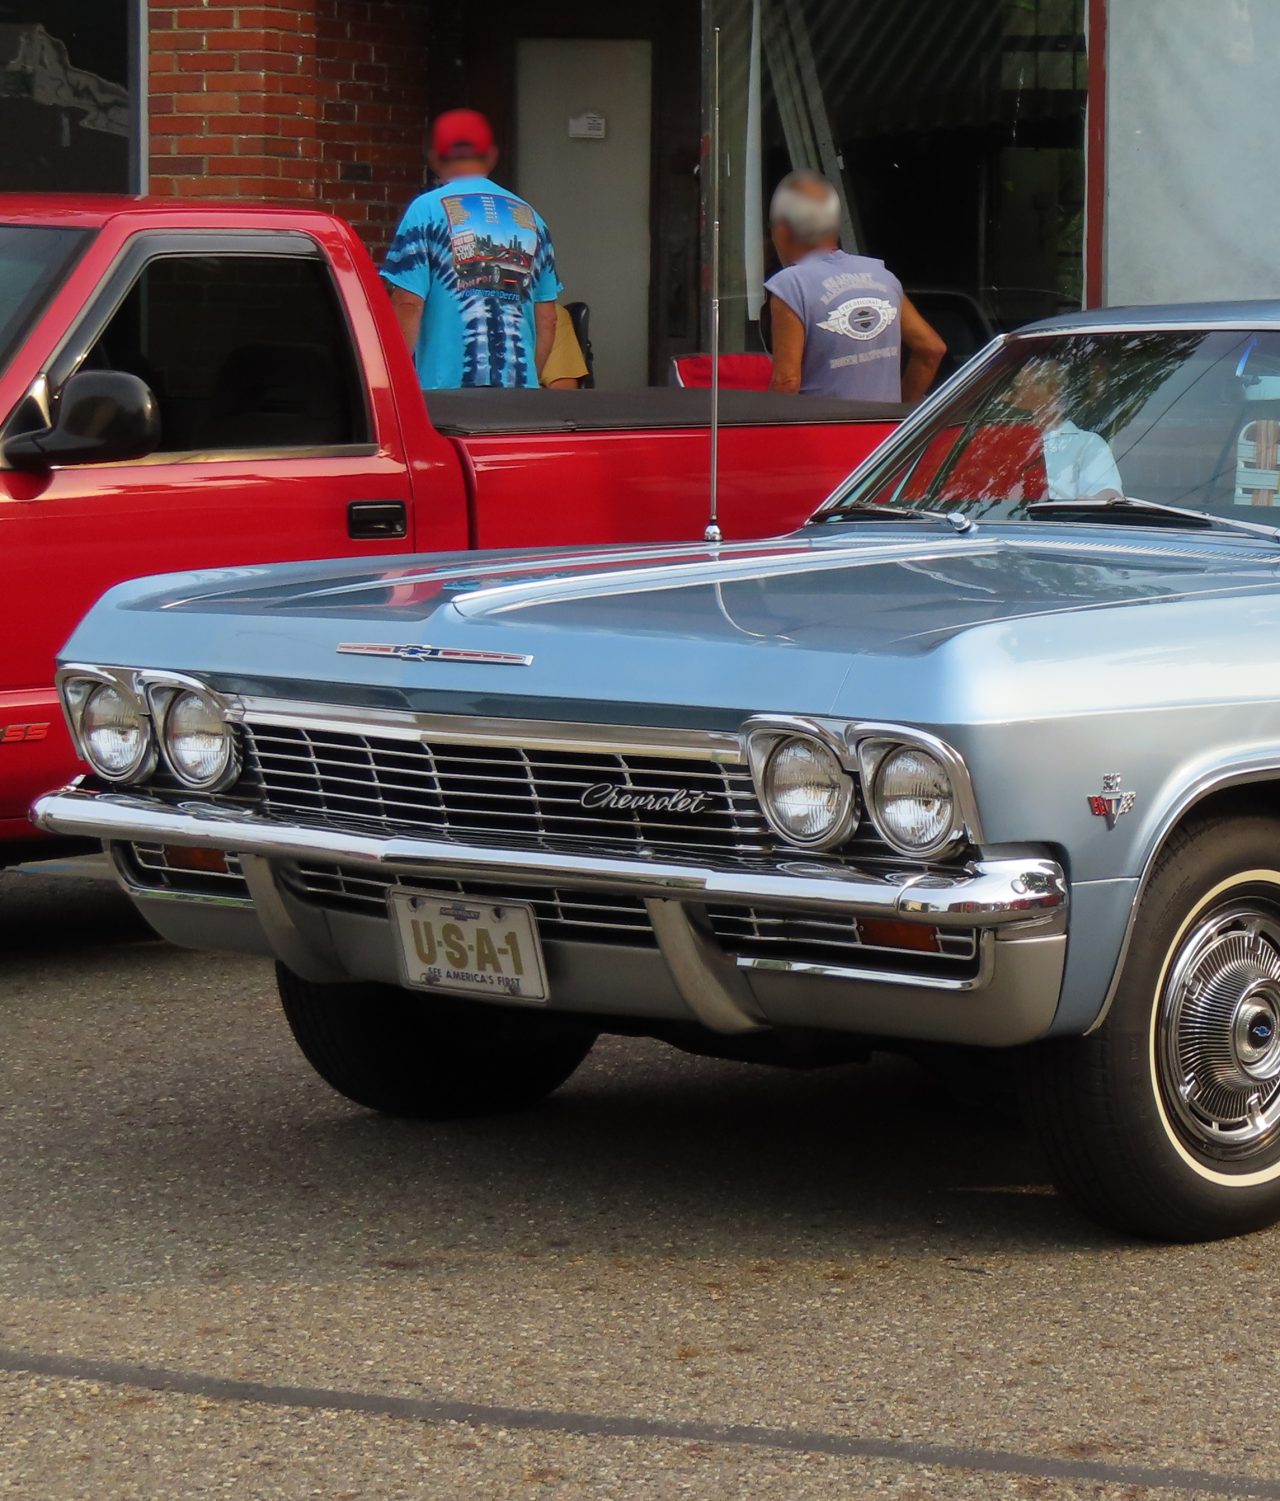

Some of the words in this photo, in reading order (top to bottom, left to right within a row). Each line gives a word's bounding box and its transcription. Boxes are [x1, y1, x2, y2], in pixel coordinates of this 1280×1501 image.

[581, 783, 712, 813] Chevrolet
[428, 967, 443, 978] SEE
[446, 970, 494, 985] AMERICA'S
[497, 976, 521, 988] FIRST
